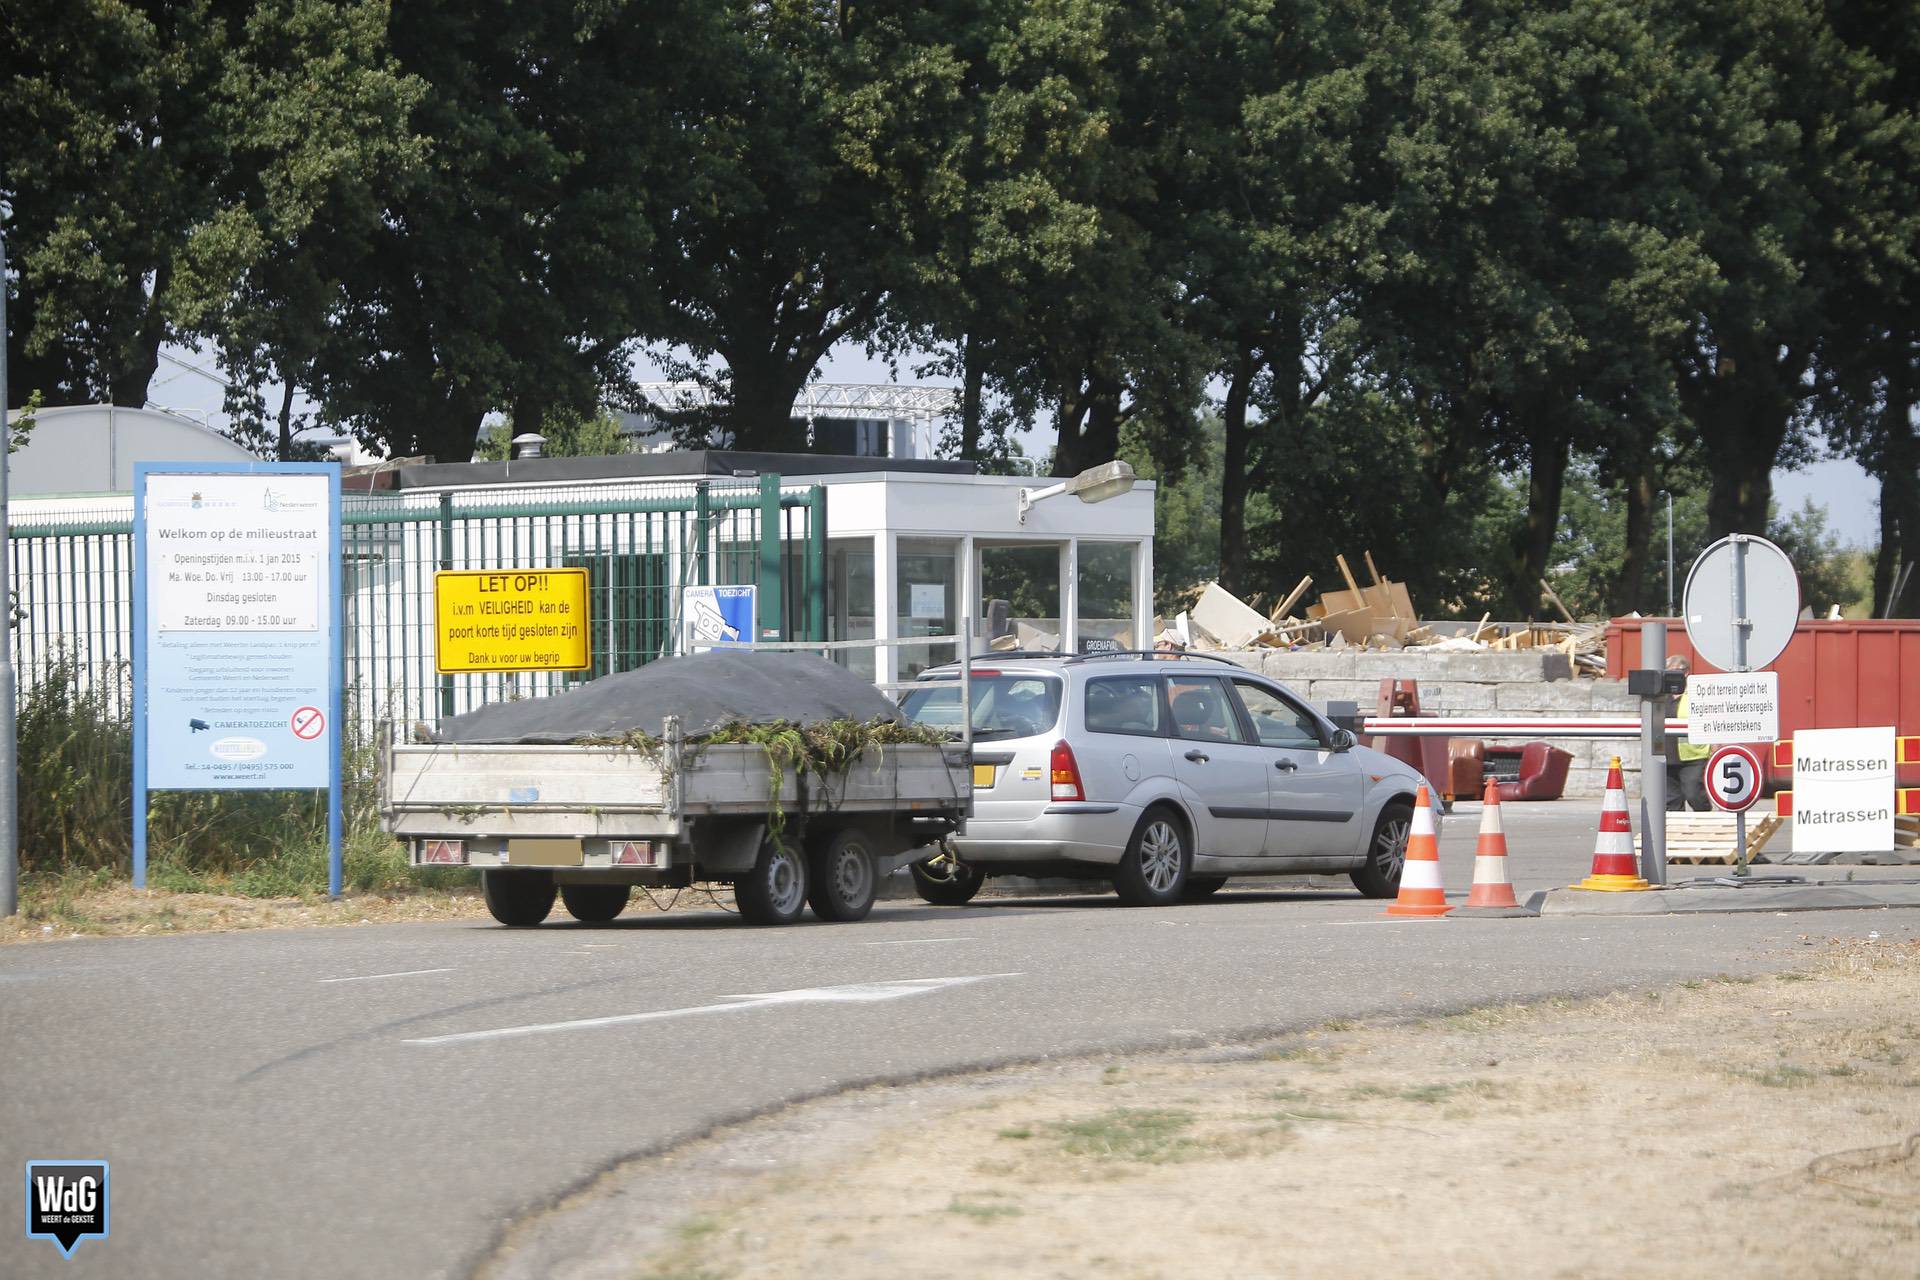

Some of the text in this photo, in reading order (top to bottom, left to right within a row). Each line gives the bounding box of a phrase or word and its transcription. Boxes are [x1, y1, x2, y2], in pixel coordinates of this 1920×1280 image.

[158, 528, 317, 541] Welkom op de milieustraat
[174, 554, 233, 565] Openingstijden
[260, 554, 264, 563] 1
[266, 554, 279, 565] jan
[282, 554, 300, 563] 2015
[169, 572, 182, 581] Ma.
[185, 572, 203, 581] Woe.
[206, 572, 218, 581] Do.
[220, 572, 233, 583] Vrij
[242, 573, 263, 581] 13.00
[271, 573, 292, 581] 17.00
[479, 575, 548, 592] LET OP!!
[207, 592, 277, 604] Dinsdag gesloten
[686, 589, 751, 598] CAMERA TOEZICHT
[453, 600, 570, 615] i.v.m VEILIGHEID kan de
[184, 615, 220, 627] Zaterdag
[226, 616, 249, 625] 09.00
[258, 616, 280, 625] 15.00
[283, 617, 296, 625] uur
[450, 623, 578, 641] poort korte tijd gesloten zijn
[469, 652, 560, 665] Dank u voor uw begrip
[1696, 682, 1767, 697] Op dit terrein geldt het
[1691, 700, 1773, 717] Reglement Verkeersregels
[1704, 720, 1761, 732] en Verkeerstekens
[1797, 757, 1887, 772] Matrassen
[1723, 761, 1744, 794] 5
[1797, 808, 1888, 825] Matrassen
